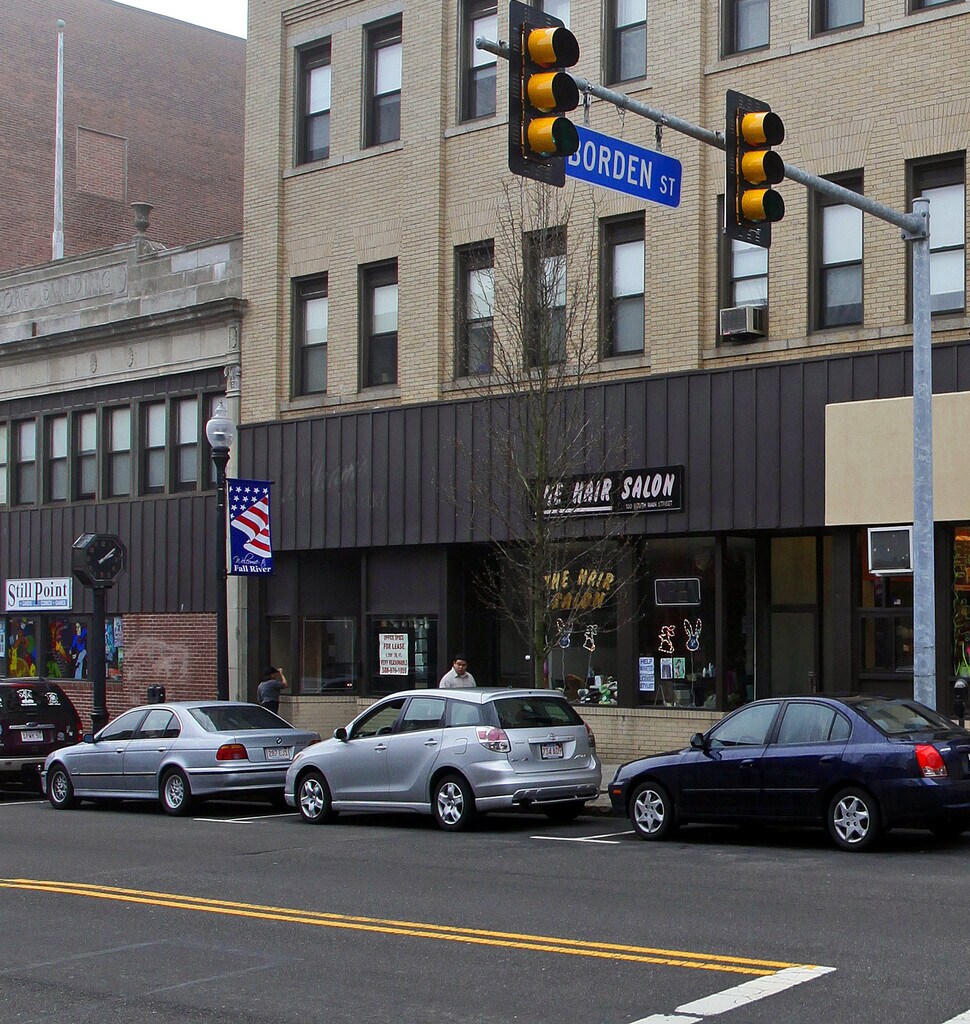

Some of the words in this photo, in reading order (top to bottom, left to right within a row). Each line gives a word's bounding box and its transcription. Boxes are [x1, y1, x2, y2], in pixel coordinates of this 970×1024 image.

[568, 140, 653, 190] BORDEN
[659, 175, 676, 197] ST
[572, 478, 612, 504] HAIR
[621, 473, 675, 500] SALON
[249, 565, 272, 573] River
[543, 570, 569, 590] THE
[576, 568, 615, 591] HAIR
[8, 583, 32, 607] Still
[34, 581, 67, 605] Point
